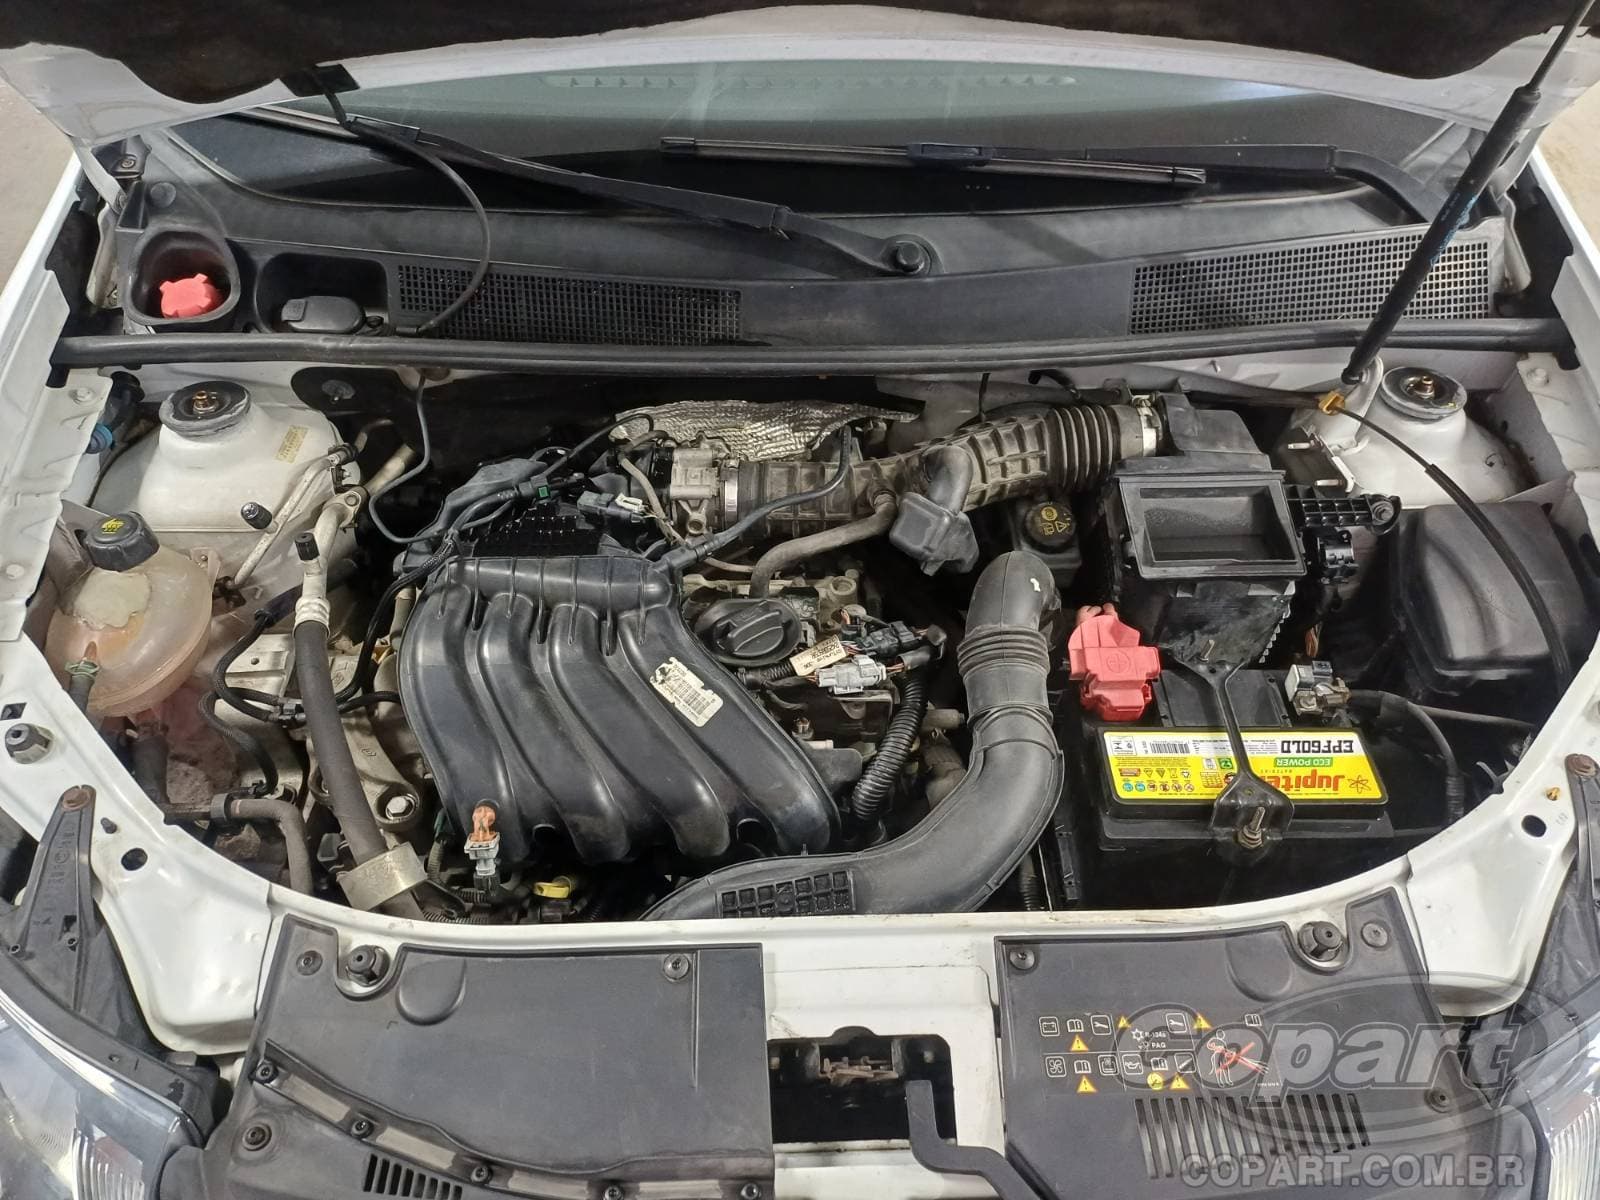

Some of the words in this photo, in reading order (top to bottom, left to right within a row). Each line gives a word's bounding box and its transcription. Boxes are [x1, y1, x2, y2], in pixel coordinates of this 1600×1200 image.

[1276, 758, 1310, 766] POWER
[1313, 758, 1331, 766] ECO
[1151, 1041, 1166, 1049] PAG
